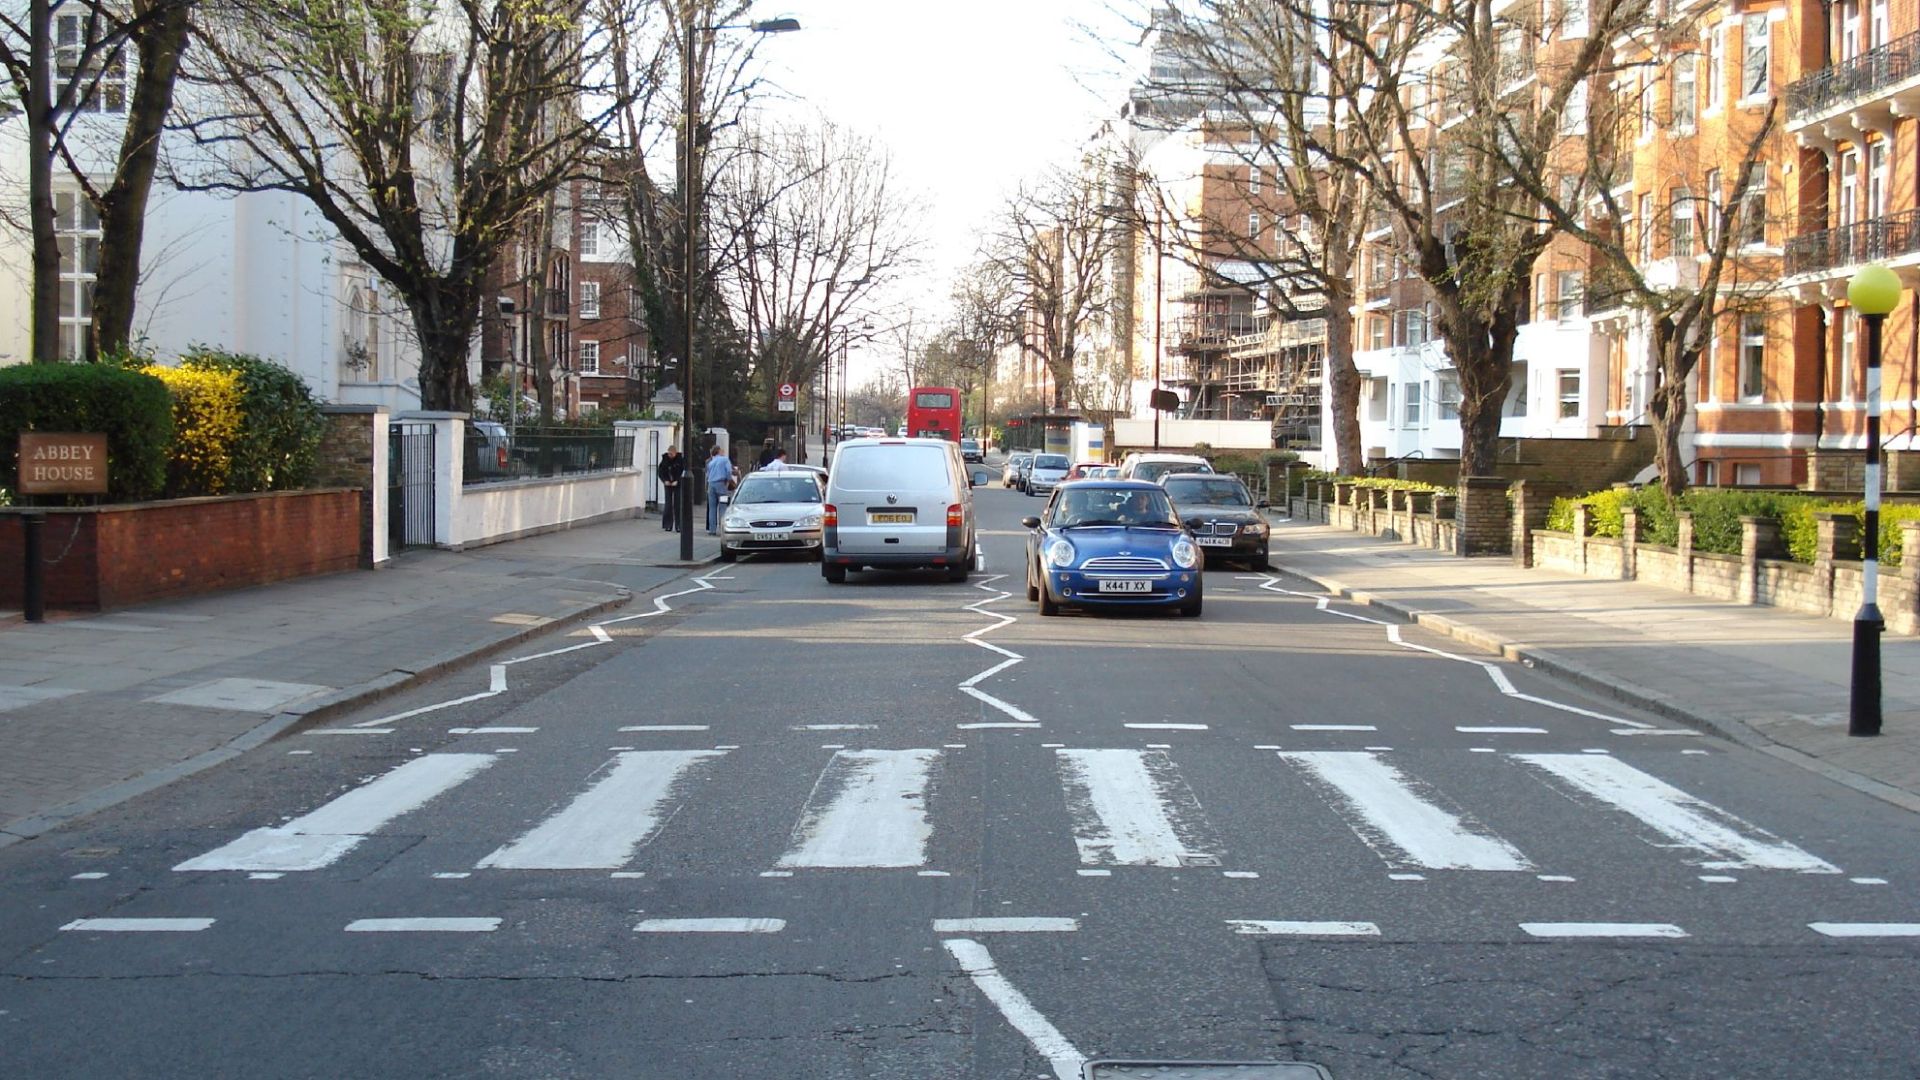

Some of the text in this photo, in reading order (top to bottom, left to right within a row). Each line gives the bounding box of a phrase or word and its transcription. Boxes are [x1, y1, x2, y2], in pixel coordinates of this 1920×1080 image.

[33, 445, 94, 460] ABBEY
[34, 466, 95, 481] HOUSE
[1105, 581, 1146, 591] K44T XX
